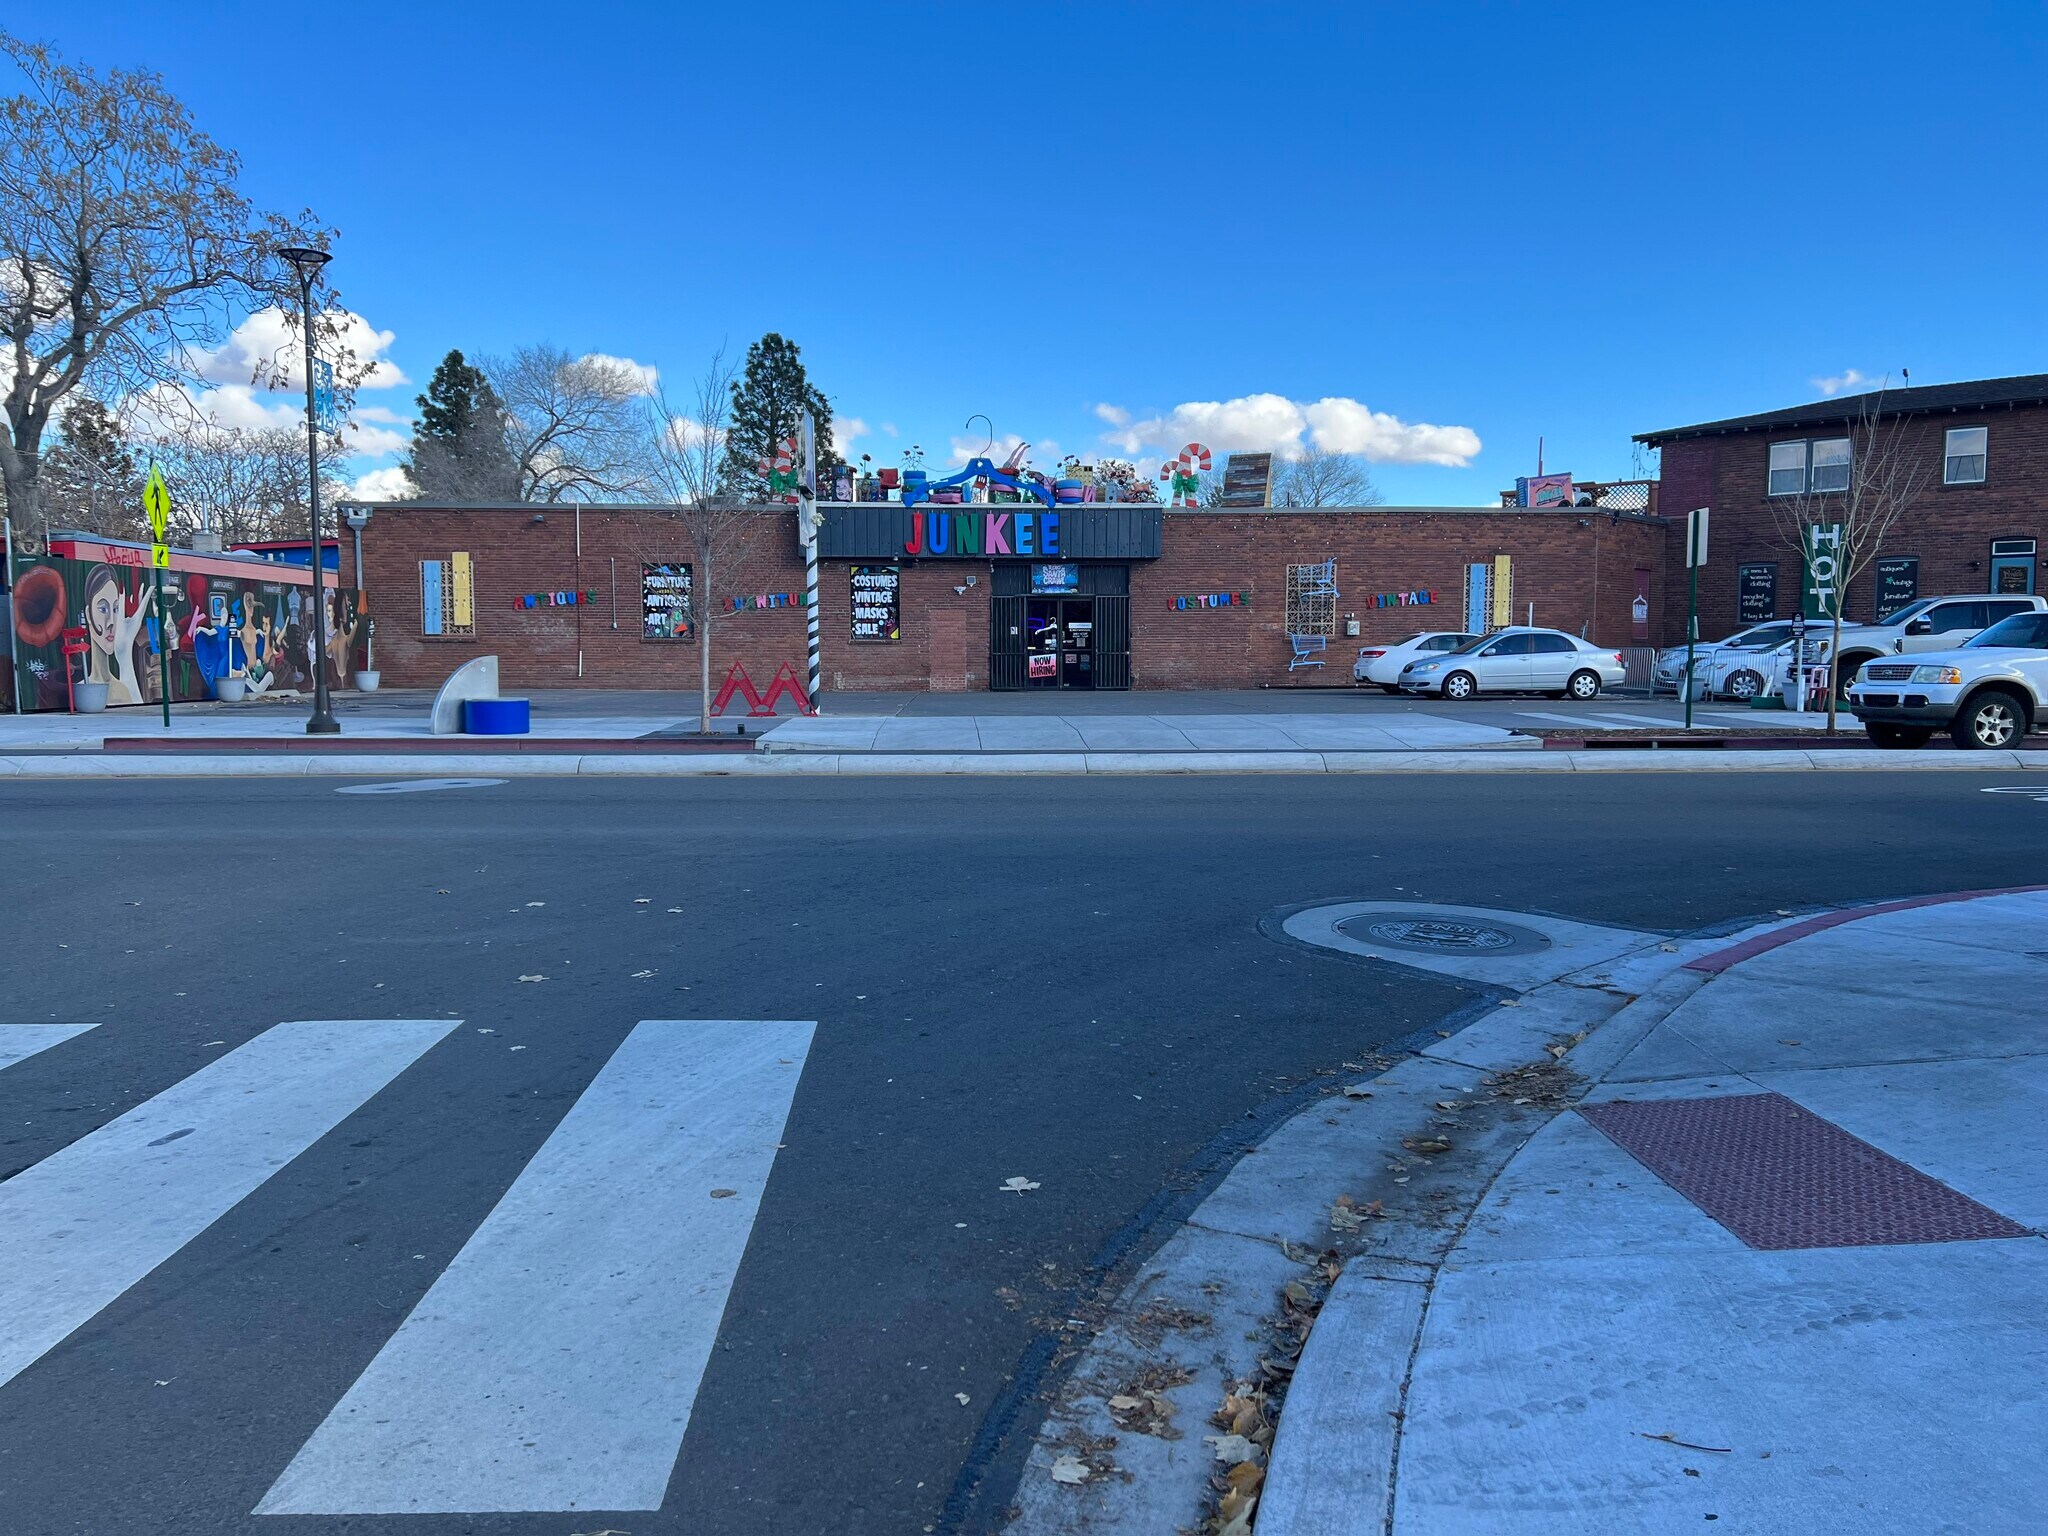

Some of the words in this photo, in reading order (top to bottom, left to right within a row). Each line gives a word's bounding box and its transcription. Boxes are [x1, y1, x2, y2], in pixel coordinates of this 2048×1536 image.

[905, 513, 1059, 555] JUNKEE
[1043, 566, 1065, 578] SANTA
[1810, 524, 1840, 613] HOT
[646, 576, 691, 589] FURNITURE
[854, 575, 898, 587] COSTUMES
[646, 595, 690, 607] ANTIQUES
[854, 591, 893, 603] VINTAGE
[1168, 591, 1249, 611] COSTUMES
[1367, 590, 1438, 609] VINTAGE
[648, 613, 668, 625] ART
[855, 607, 889, 619] MASKS
[855, 623, 878, 635] SALE
[1034, 656, 1052, 666] NOW
[1030, 665, 1056, 677] HIRING
